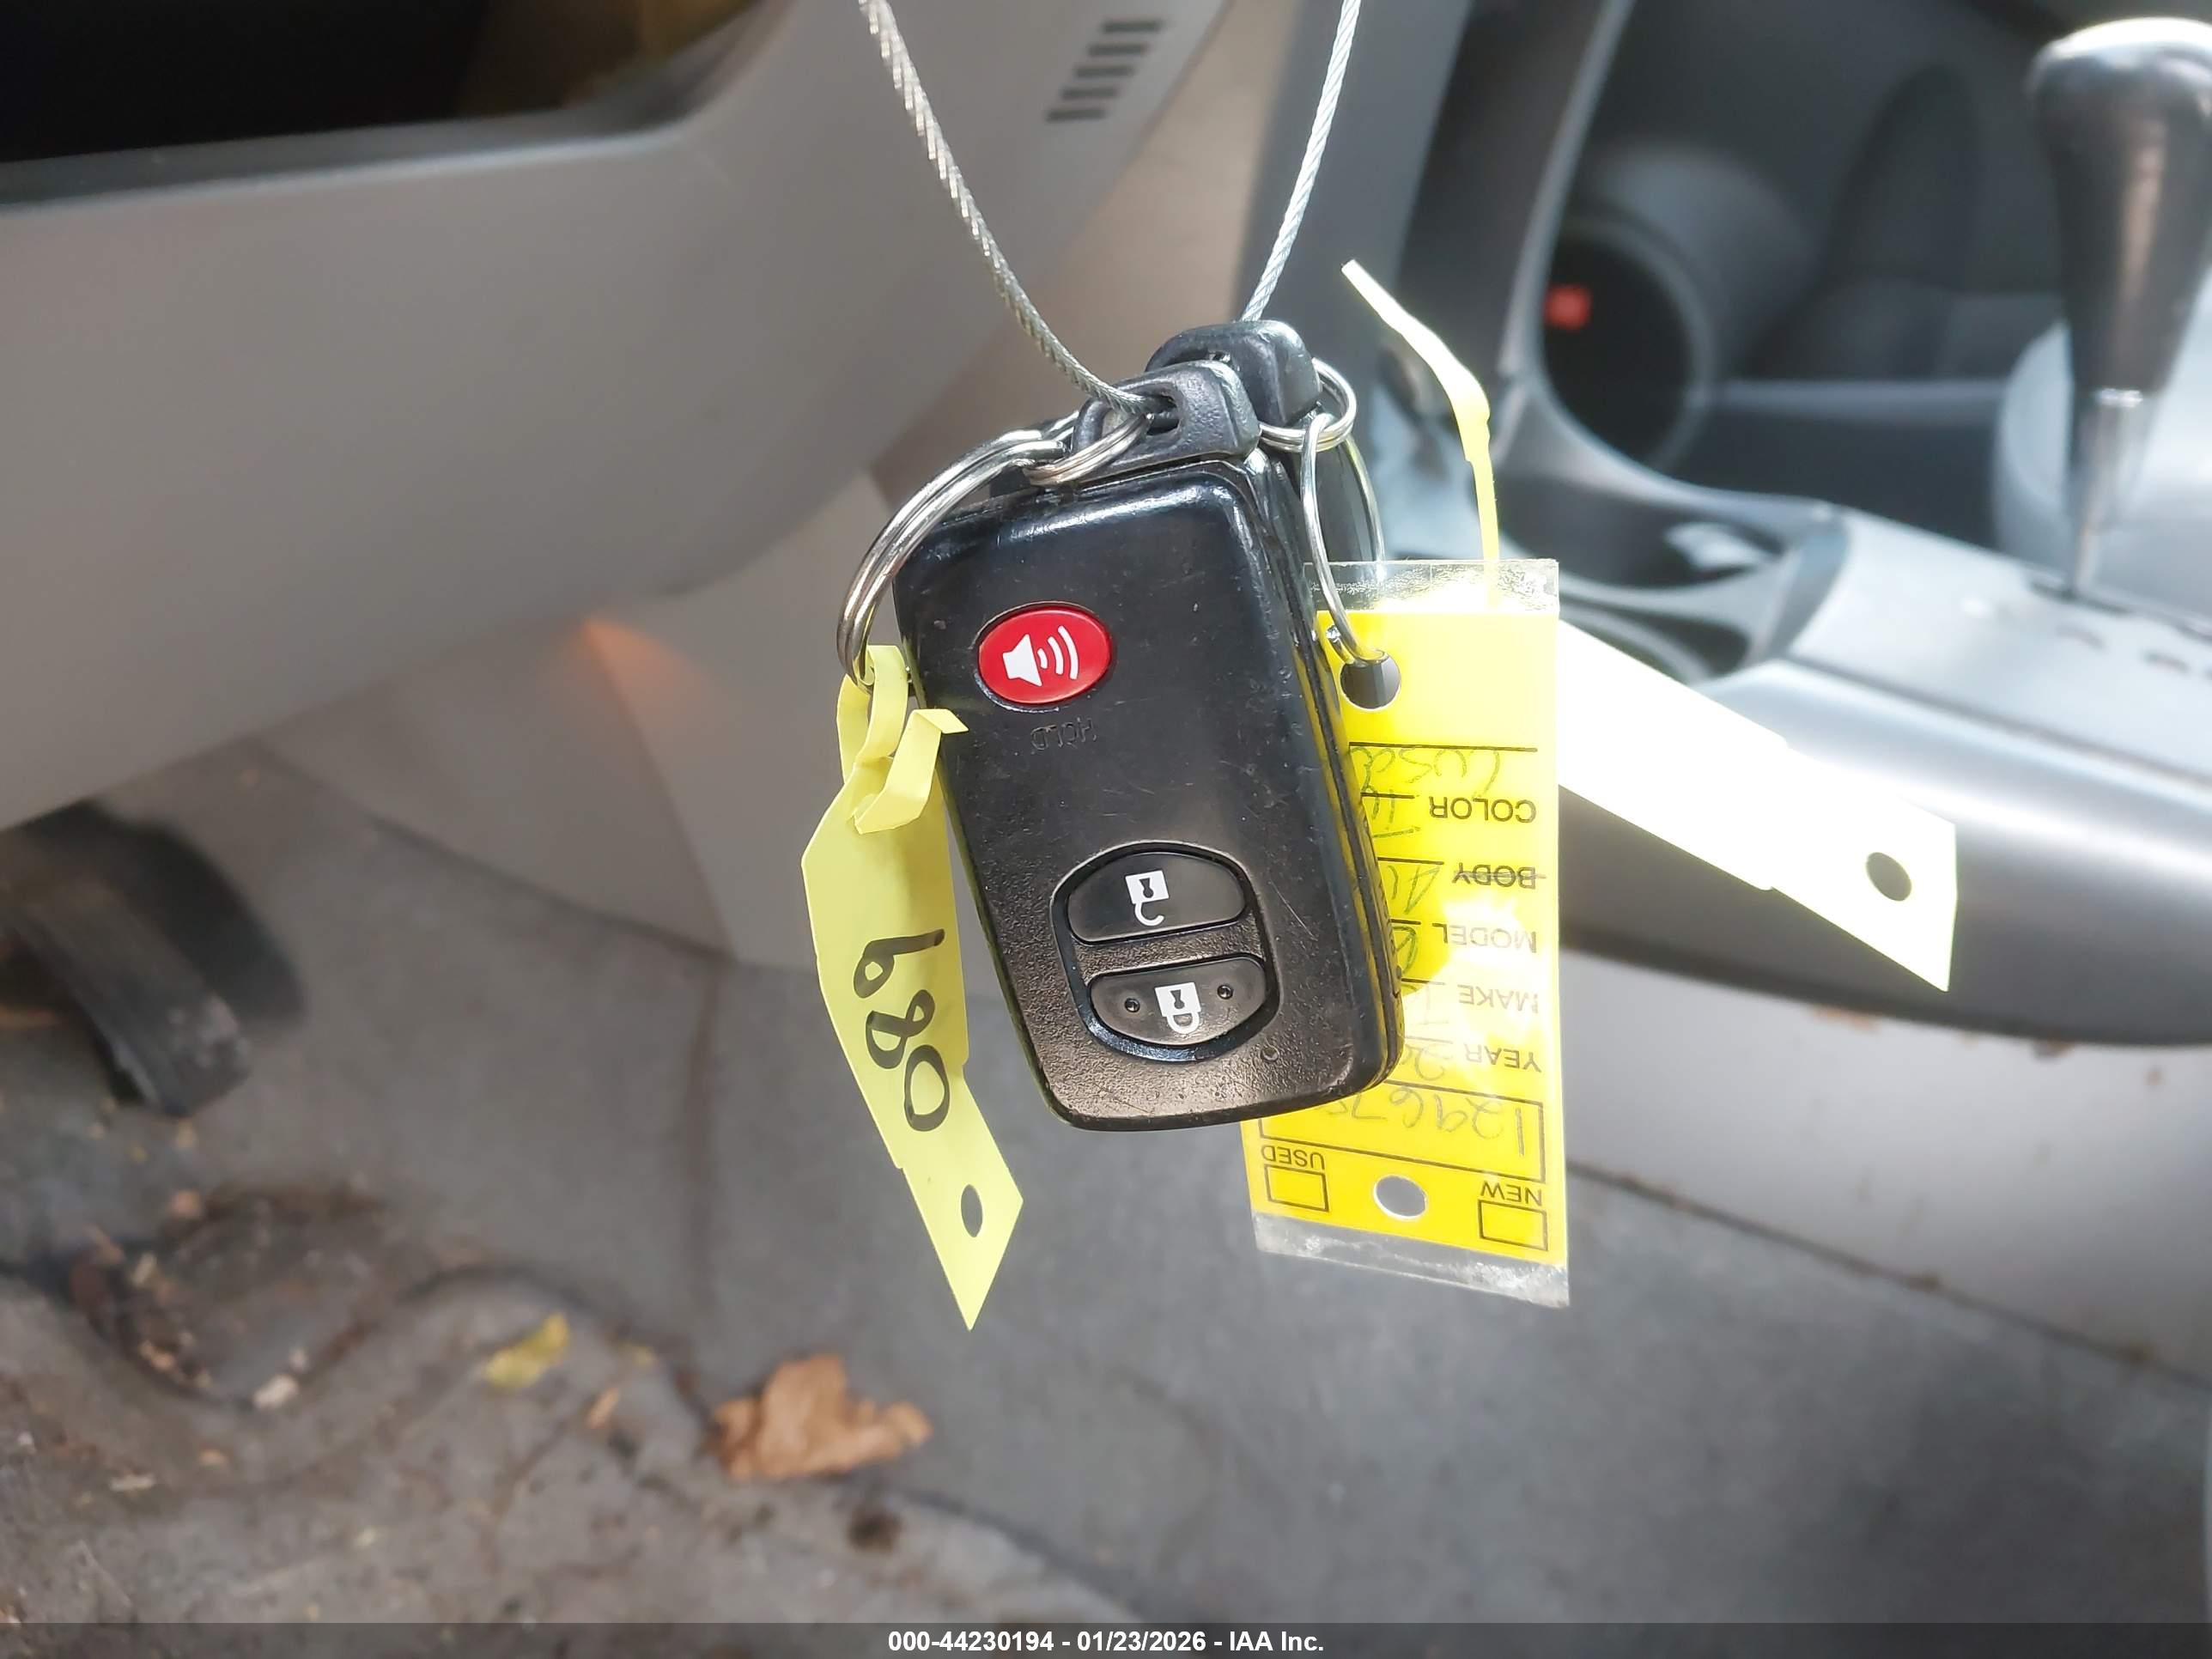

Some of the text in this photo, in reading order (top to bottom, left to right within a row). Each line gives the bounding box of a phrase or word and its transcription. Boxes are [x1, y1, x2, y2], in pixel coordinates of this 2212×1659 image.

[1429, 797, 1537, 823] COLOR
[1452, 862, 1536, 890] BODY
[1431, 922, 1536, 953] MODEL
[1458, 984, 1539, 1013] MAKE
[1463, 1043, 1542, 1073] YEAR
[1261, 1145, 1326, 1170] USED
[1481, 1181, 1542, 1207] NEW
